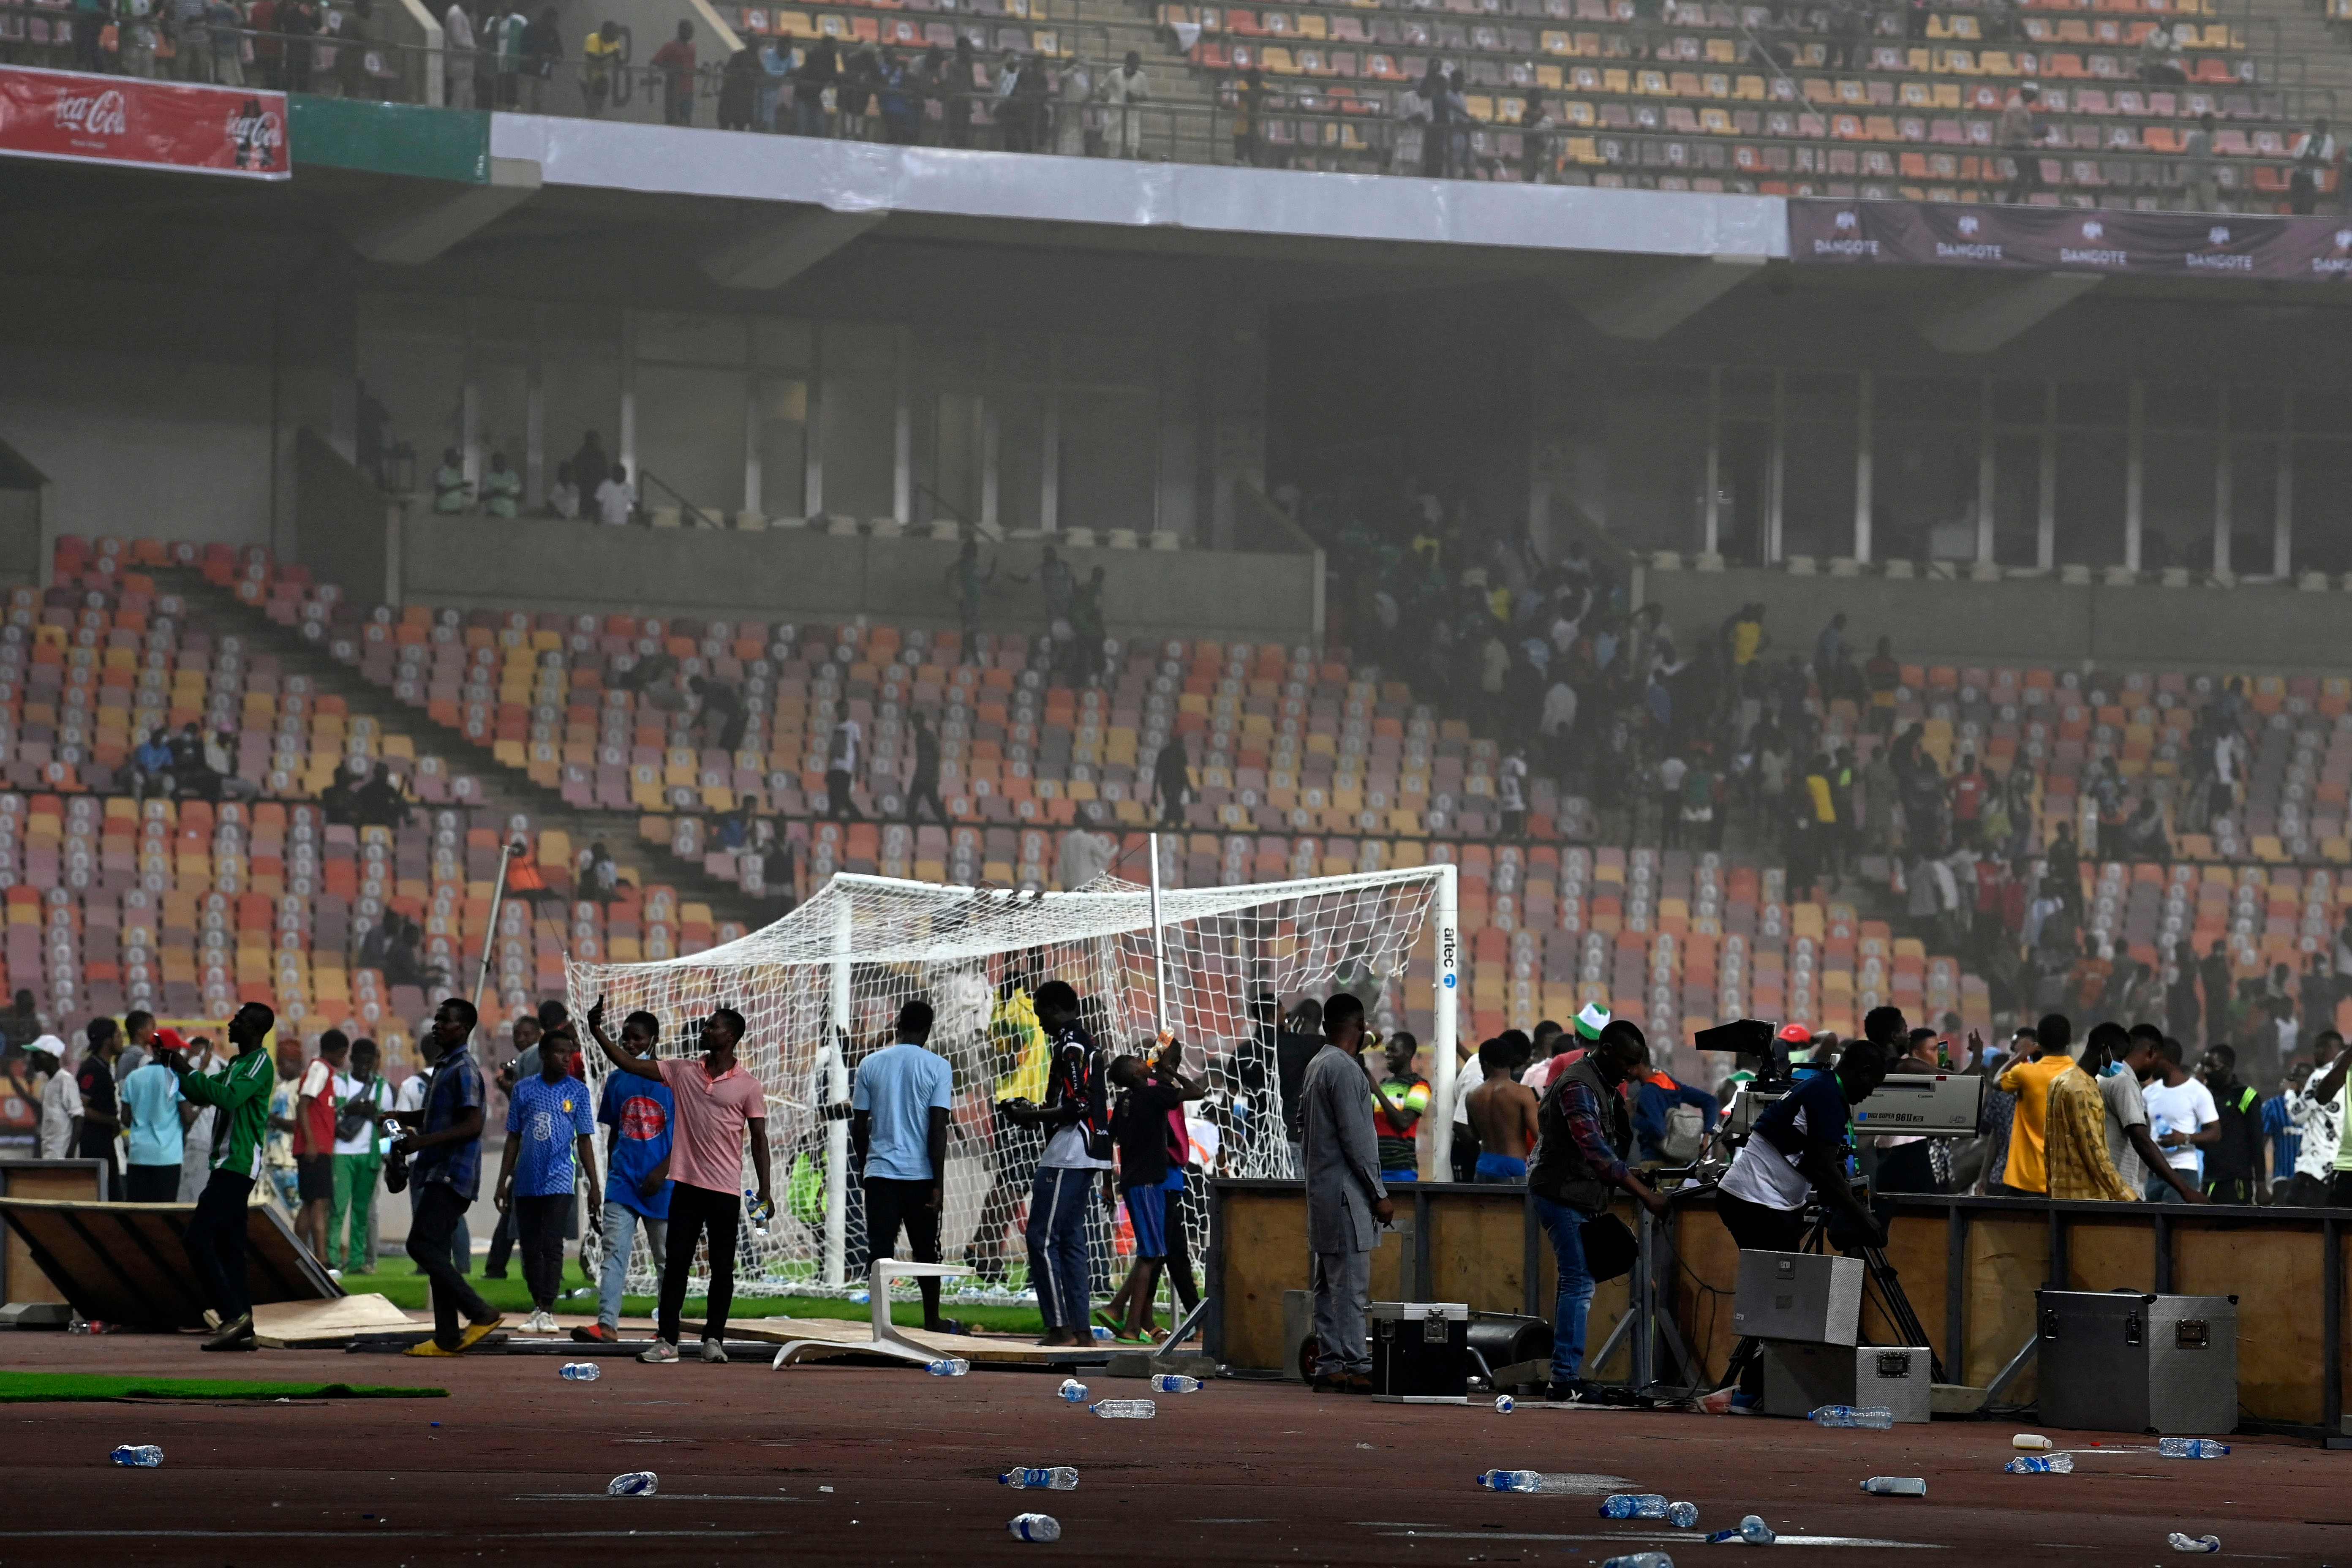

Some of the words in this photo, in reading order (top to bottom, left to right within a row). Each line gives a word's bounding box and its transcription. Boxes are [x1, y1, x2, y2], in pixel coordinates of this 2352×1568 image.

[1814, 239, 1879, 256] DANGOTE
[1936, 242, 2002, 260] DANGOTE
[2060, 248, 2127, 266] DANGOTE
[2186, 253, 2253, 271] DANGOTE
[1443, 927, 1456, 968] artec
